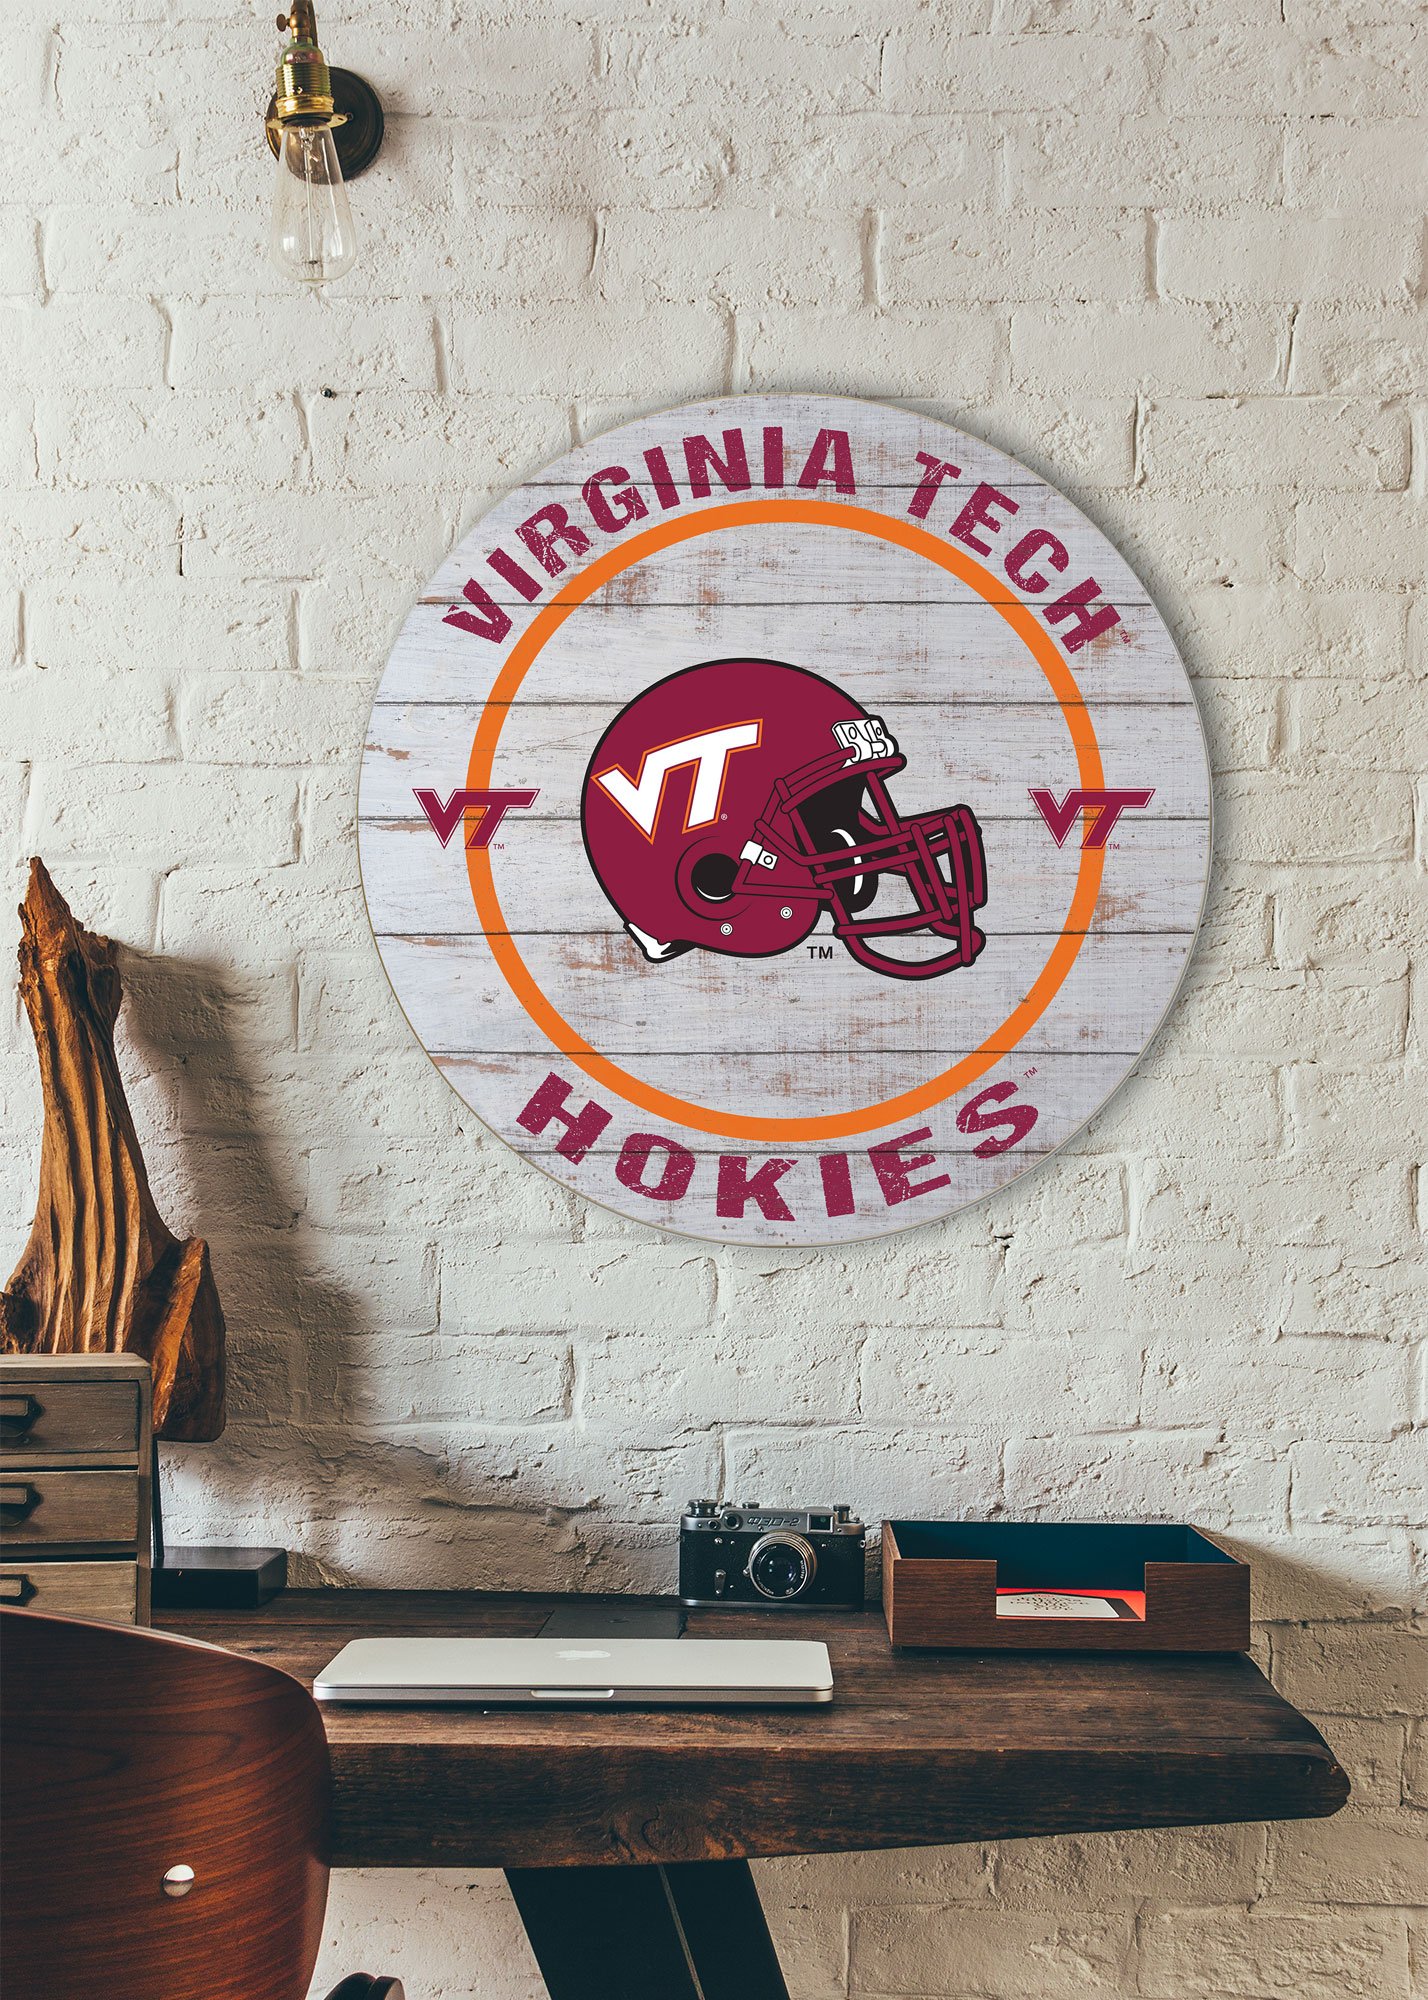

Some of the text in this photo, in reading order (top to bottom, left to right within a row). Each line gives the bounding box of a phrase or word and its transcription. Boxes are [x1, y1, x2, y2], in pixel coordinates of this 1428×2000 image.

[443, 426, 856, 644] VIRGINIA
[908, 452, 1121, 654] TECH
[413, 788, 539, 849] VT
[590, 718, 763, 844] VT
[1028, 788, 1155, 849] VT
[807, 946, 832, 959] TM
[516, 1072, 1039, 1221] HOKIES
